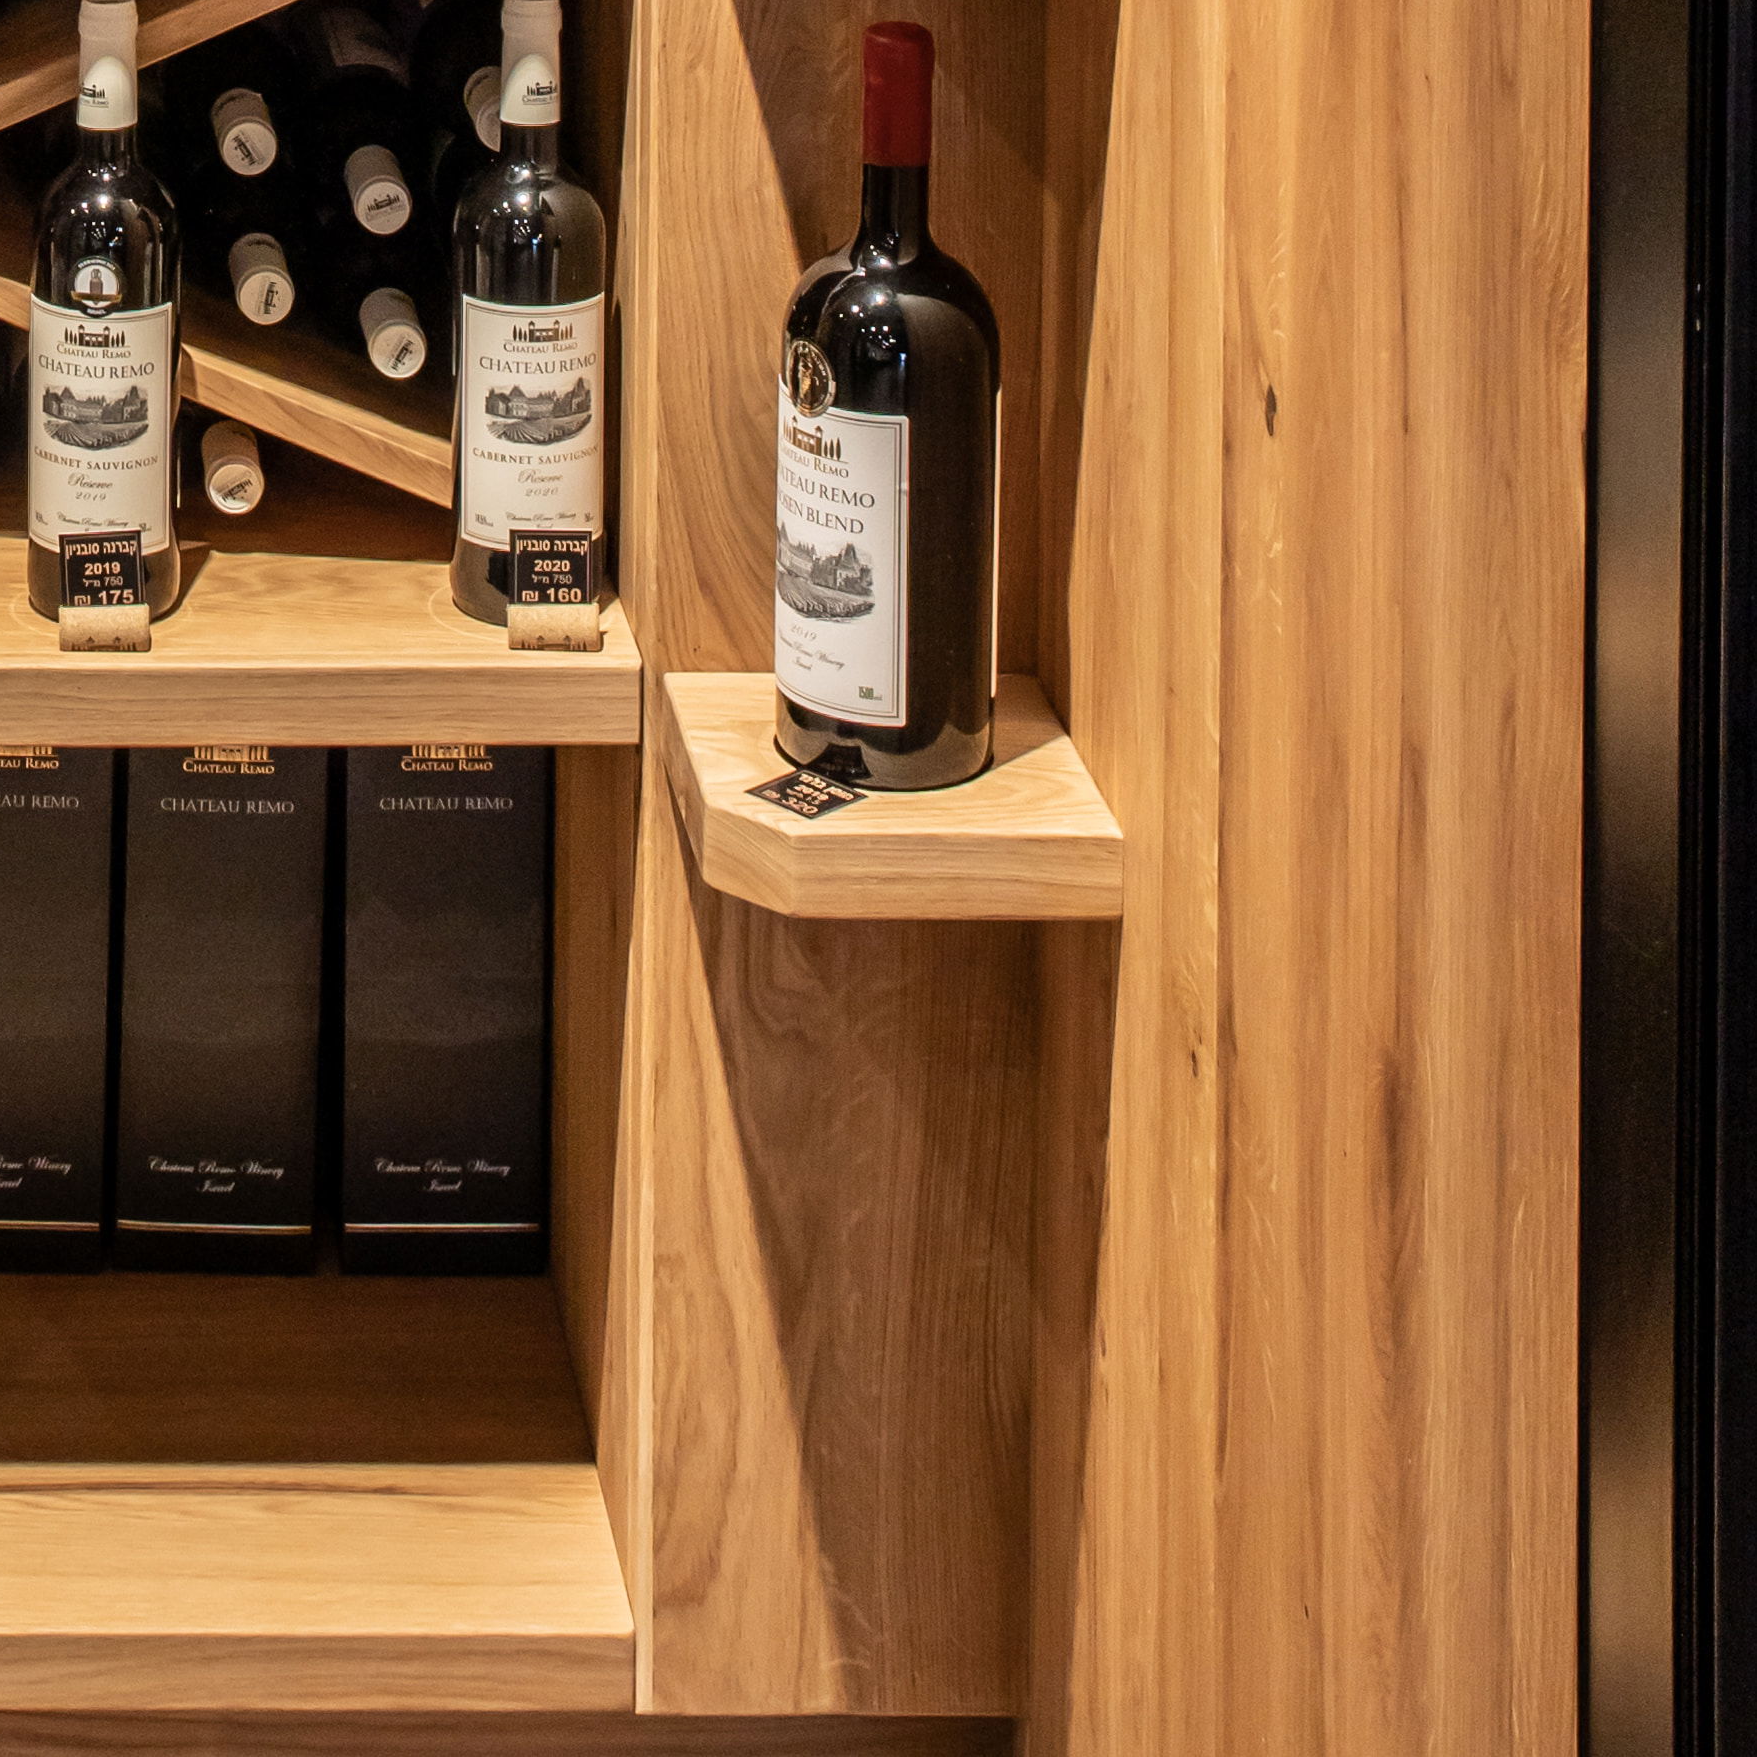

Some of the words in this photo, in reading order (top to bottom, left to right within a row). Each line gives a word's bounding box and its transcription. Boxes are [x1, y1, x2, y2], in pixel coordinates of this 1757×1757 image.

[38, 355, 105, 379] CHATEAU
[109, 362, 155, 379] REMO
[479, 356, 556, 375] CHATEAU
[559, 352, 597, 373] REMO
[34, 449, 81, 469] CABERNET
[87, 455, 158, 470] SAUVIGNON
[473, 447, 532, 464] CABERNET
[539, 446, 598, 464] SAUVIGNON
[813, 456, 849, 479] REMO
[819, 483, 875, 509] REMO
[806, 507, 864, 534] BLEND
[84, 562, 121, 576] 2019
[534, 560, 571, 572] 2020
[98, 589, 135, 605] 175
[546, 588, 582, 603] 160
[379, 796, 459, 811] CHATEAU
[465, 796, 514, 811] REMO
